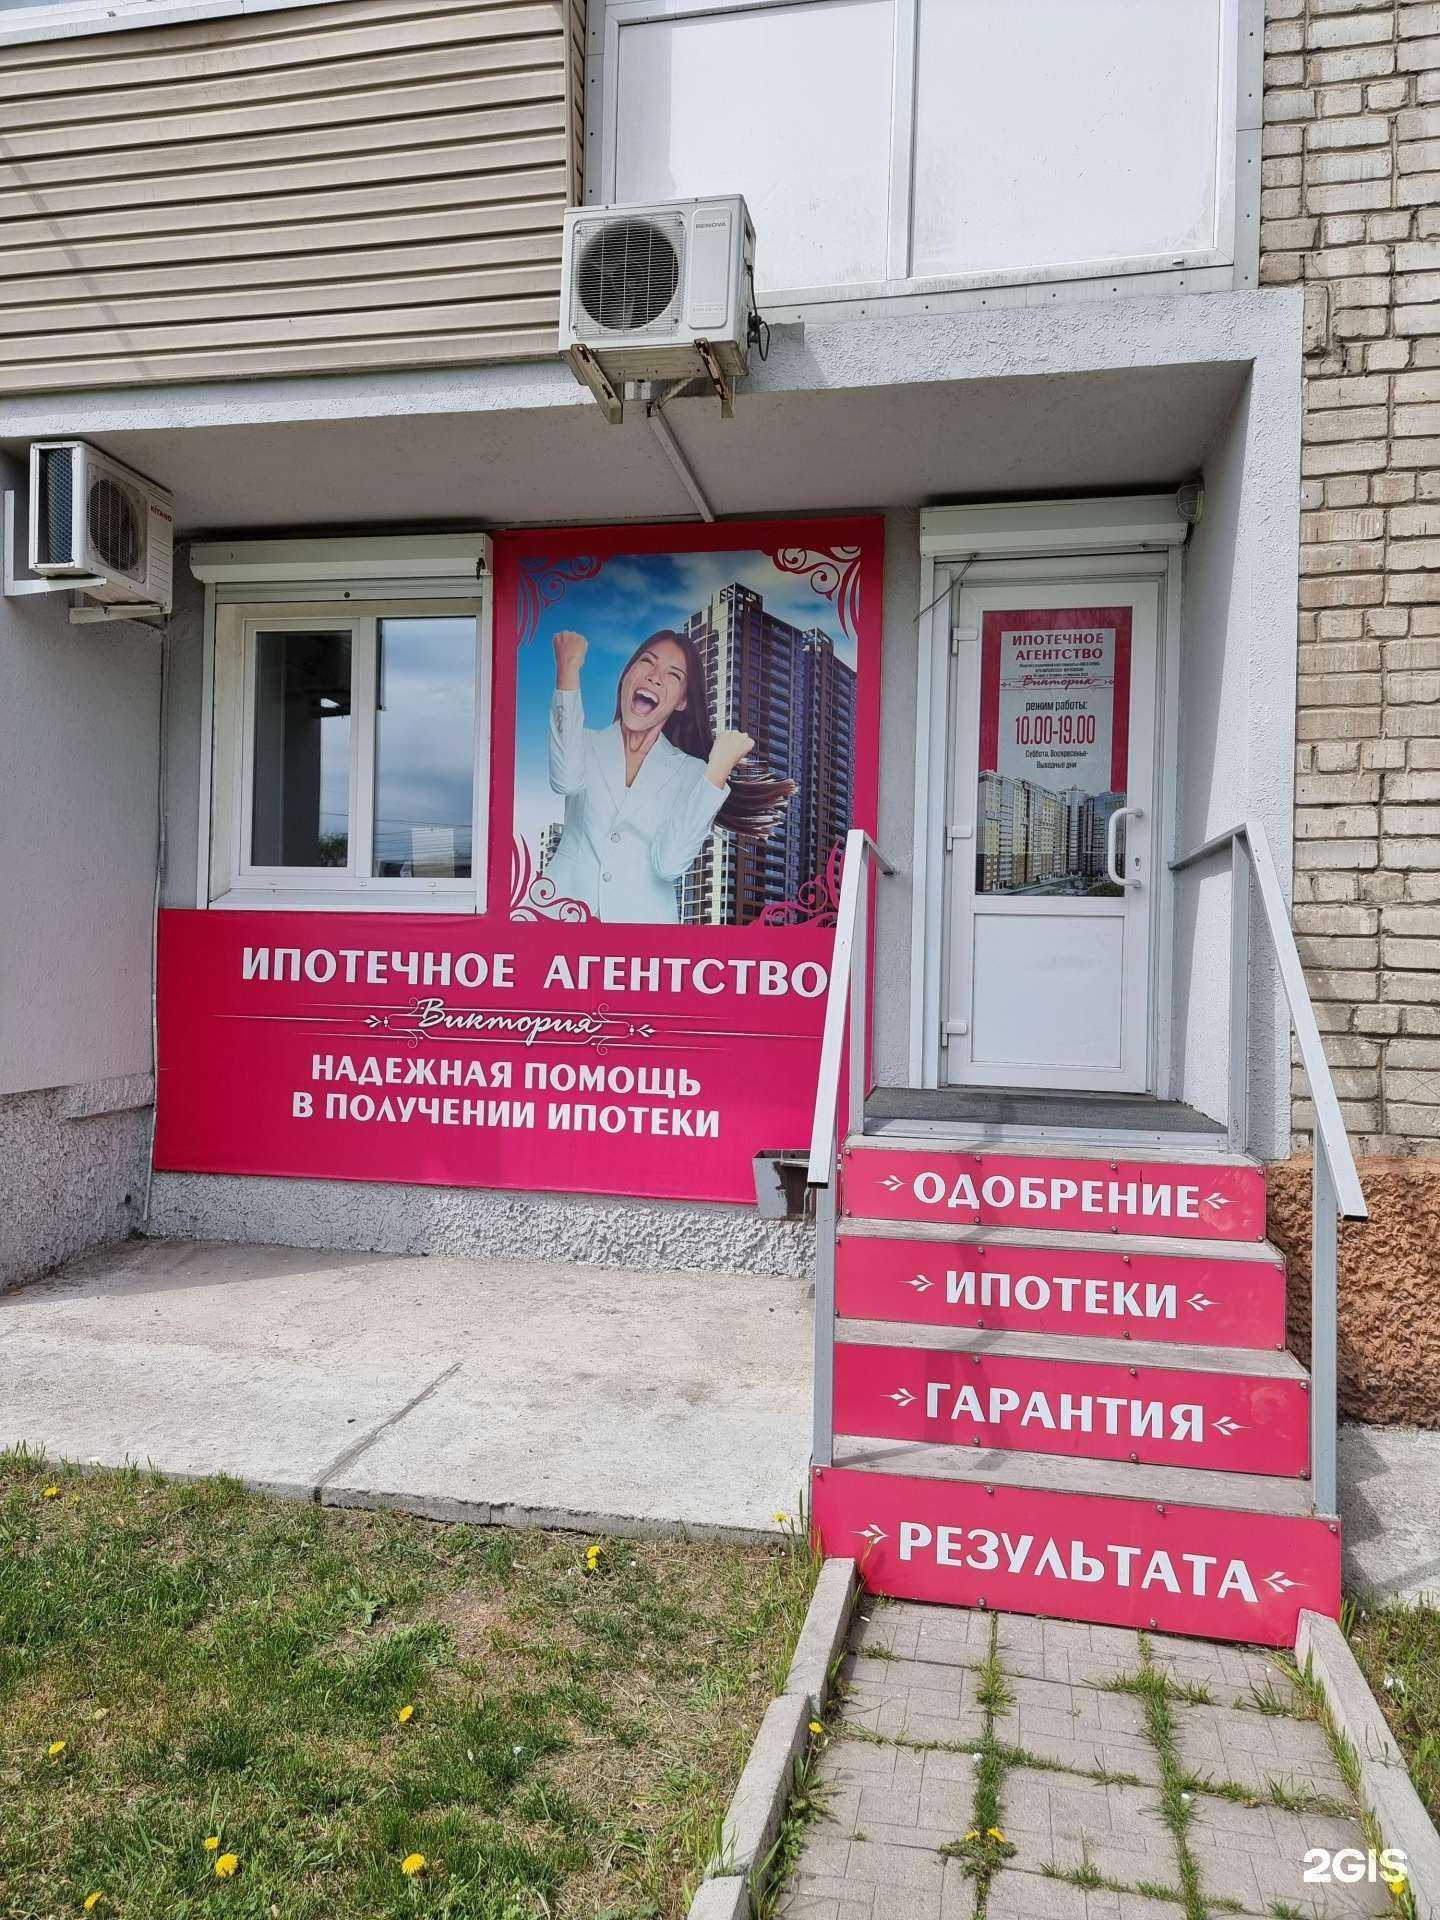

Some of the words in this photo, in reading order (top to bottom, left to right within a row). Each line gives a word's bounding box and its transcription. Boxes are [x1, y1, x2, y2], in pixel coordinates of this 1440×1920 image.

[1012, 633, 1104, 646] ИПОТЕЧНОЕ
[1015, 648, 1103, 660] АГЕНТСТВО
[1022, 674, 1094, 690] Виктория
[1025, 702, 1054, 711] режим
[1055, 700, 1088, 711] работы:
[1015, 714, 1096, 745] 10.00-19.00
[242, 947, 515, 988] ИПОТЕЧНОЕ
[543, 955, 828, 998] АГЕНТСТВО
[418, 998, 602, 1047] Виктория
[312, 1054, 512, 1088] НАДЕЖНАЯ
[525, 1062, 701, 1098] ПОМОЩЬ
[292, 1092, 314, 1118] В
[325, 1094, 535, 1129] ПОЛУЧЕНИИ
[548, 1103, 719, 1138] ИПОТЕКИ
[913, 1171, 1200, 1219] ОДОБРЕНИЕ
[945, 1270, 1177, 1319] ИПОТЕКИ
[926, 1382, 1204, 1442] ГАРАНТИЯ
[899, 1521, 1258, 1603] РЕЗУЛЬТАТА
